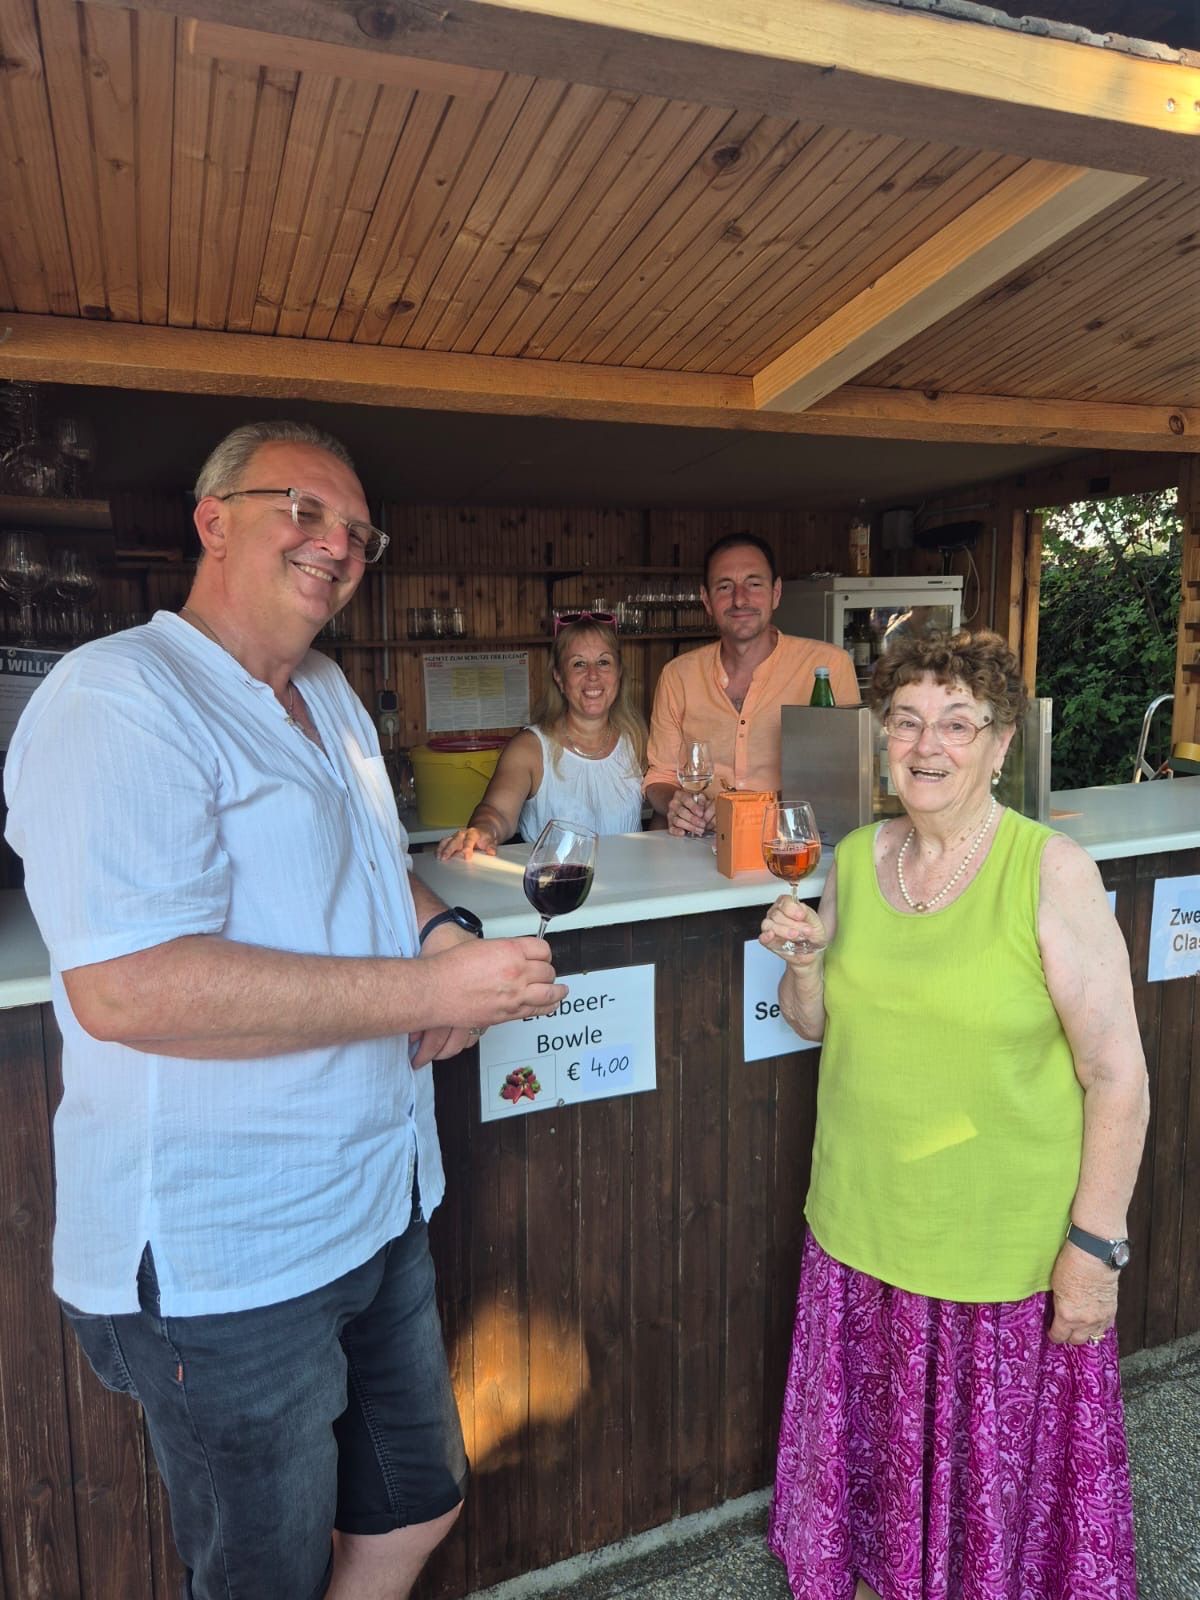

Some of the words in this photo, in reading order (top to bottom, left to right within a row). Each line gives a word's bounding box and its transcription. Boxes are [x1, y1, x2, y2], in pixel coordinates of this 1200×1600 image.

[1173, 933, 1200, 952] Cla
[522, 993, 616, 1022] beer-
[755, 1001, 780, 1020] Se
[537, 1025, 602, 1054] Bowle
[567, 1062, 580, 1081] €
[591, 1056, 629, 1077] 4,00
